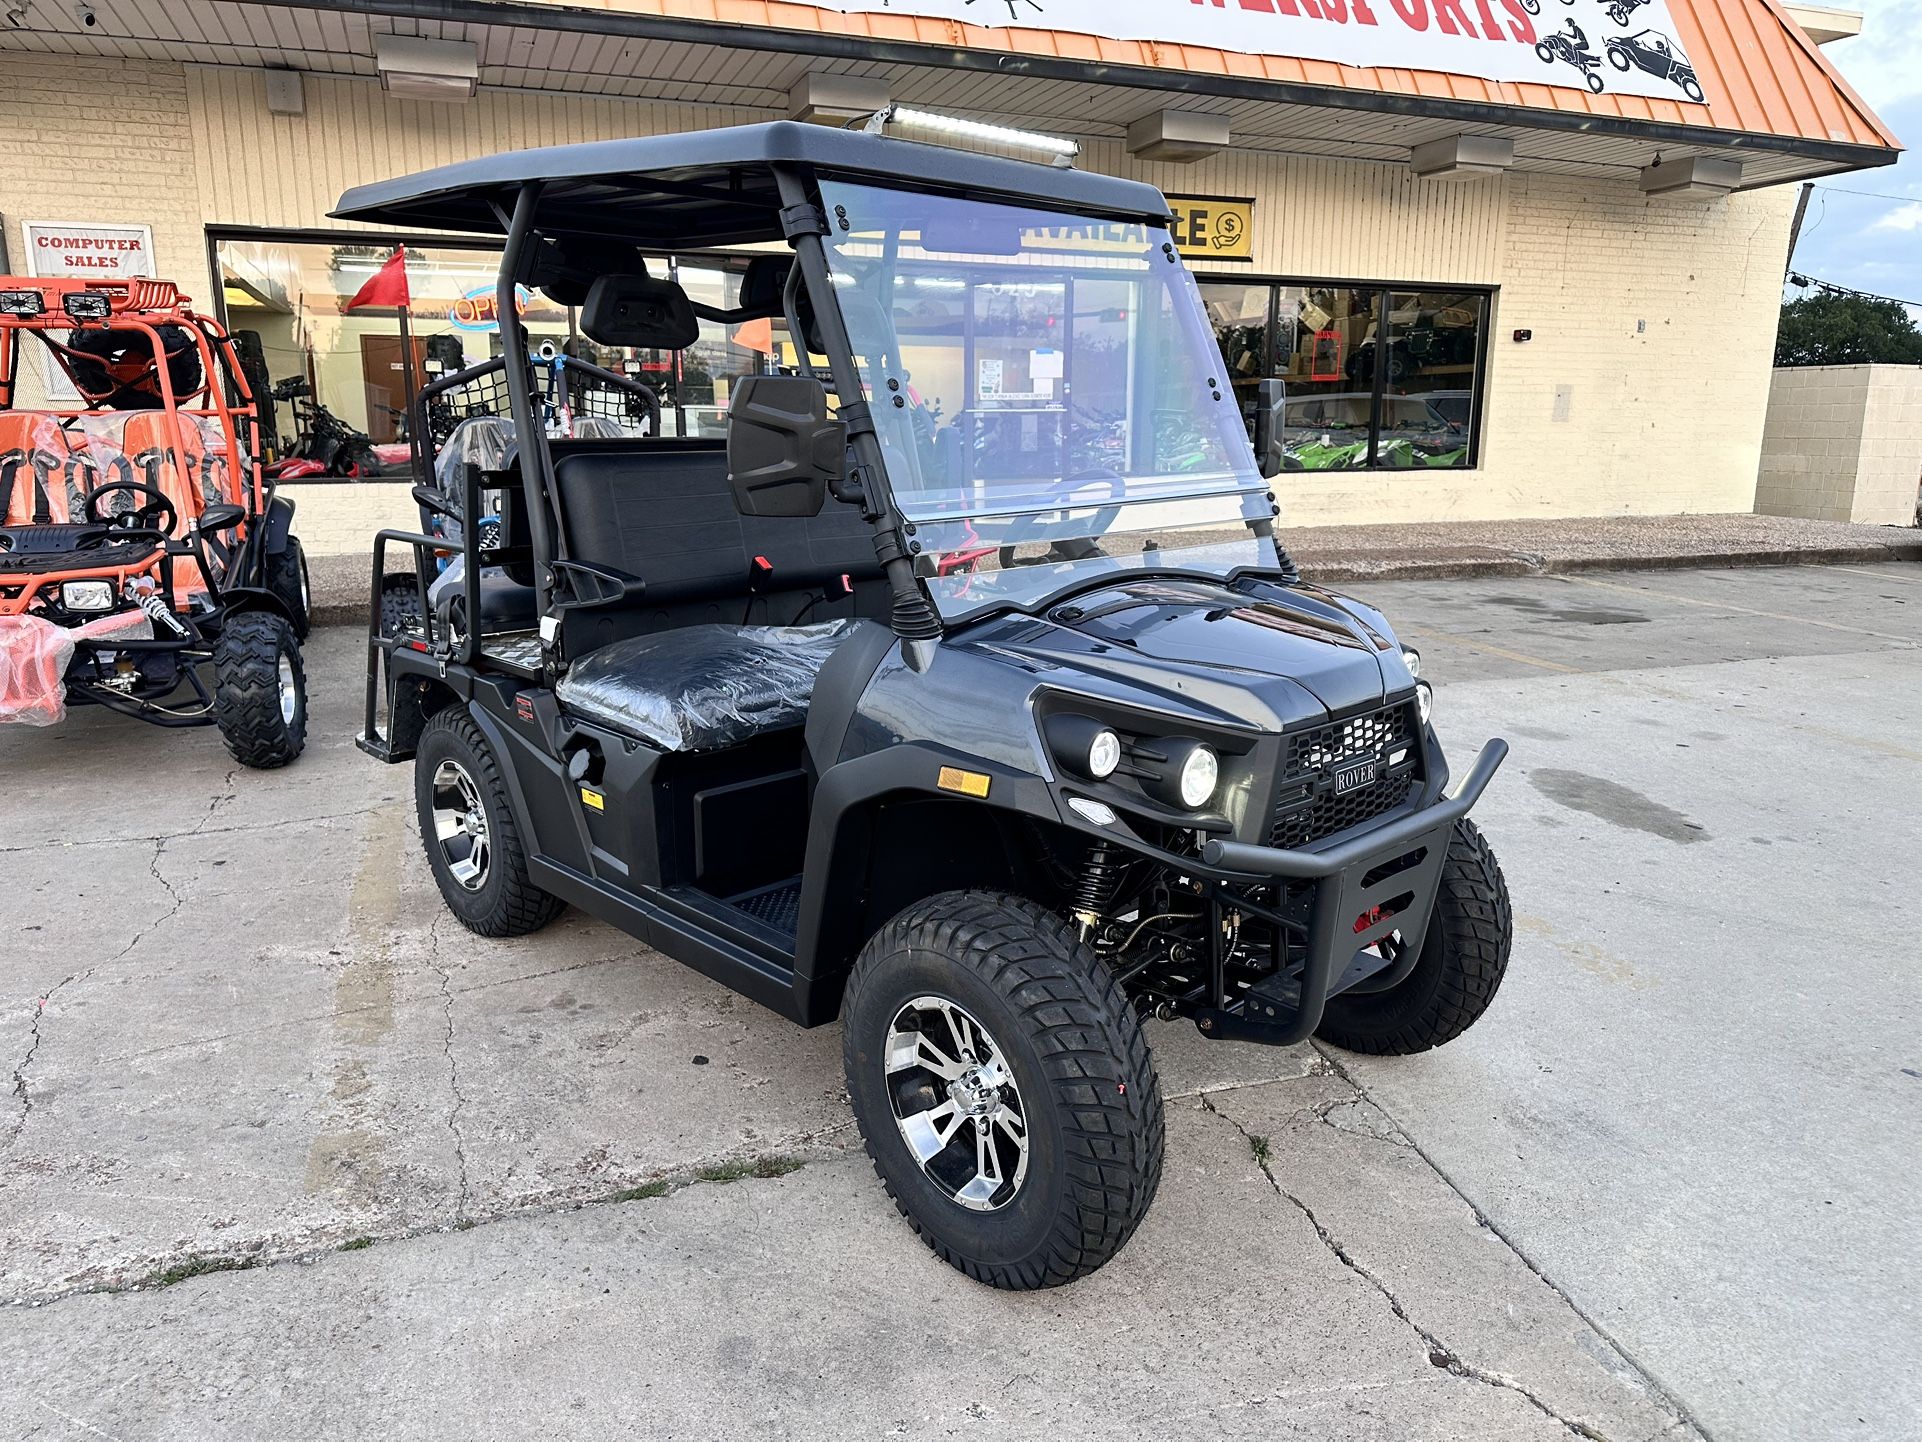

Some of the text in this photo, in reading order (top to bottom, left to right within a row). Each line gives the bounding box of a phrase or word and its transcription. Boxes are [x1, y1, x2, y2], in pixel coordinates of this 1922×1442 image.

[37, 236, 142, 251] COMPUTER
[64, 255, 119, 268] SALES
[1338, 764, 1374, 790] ROVER
